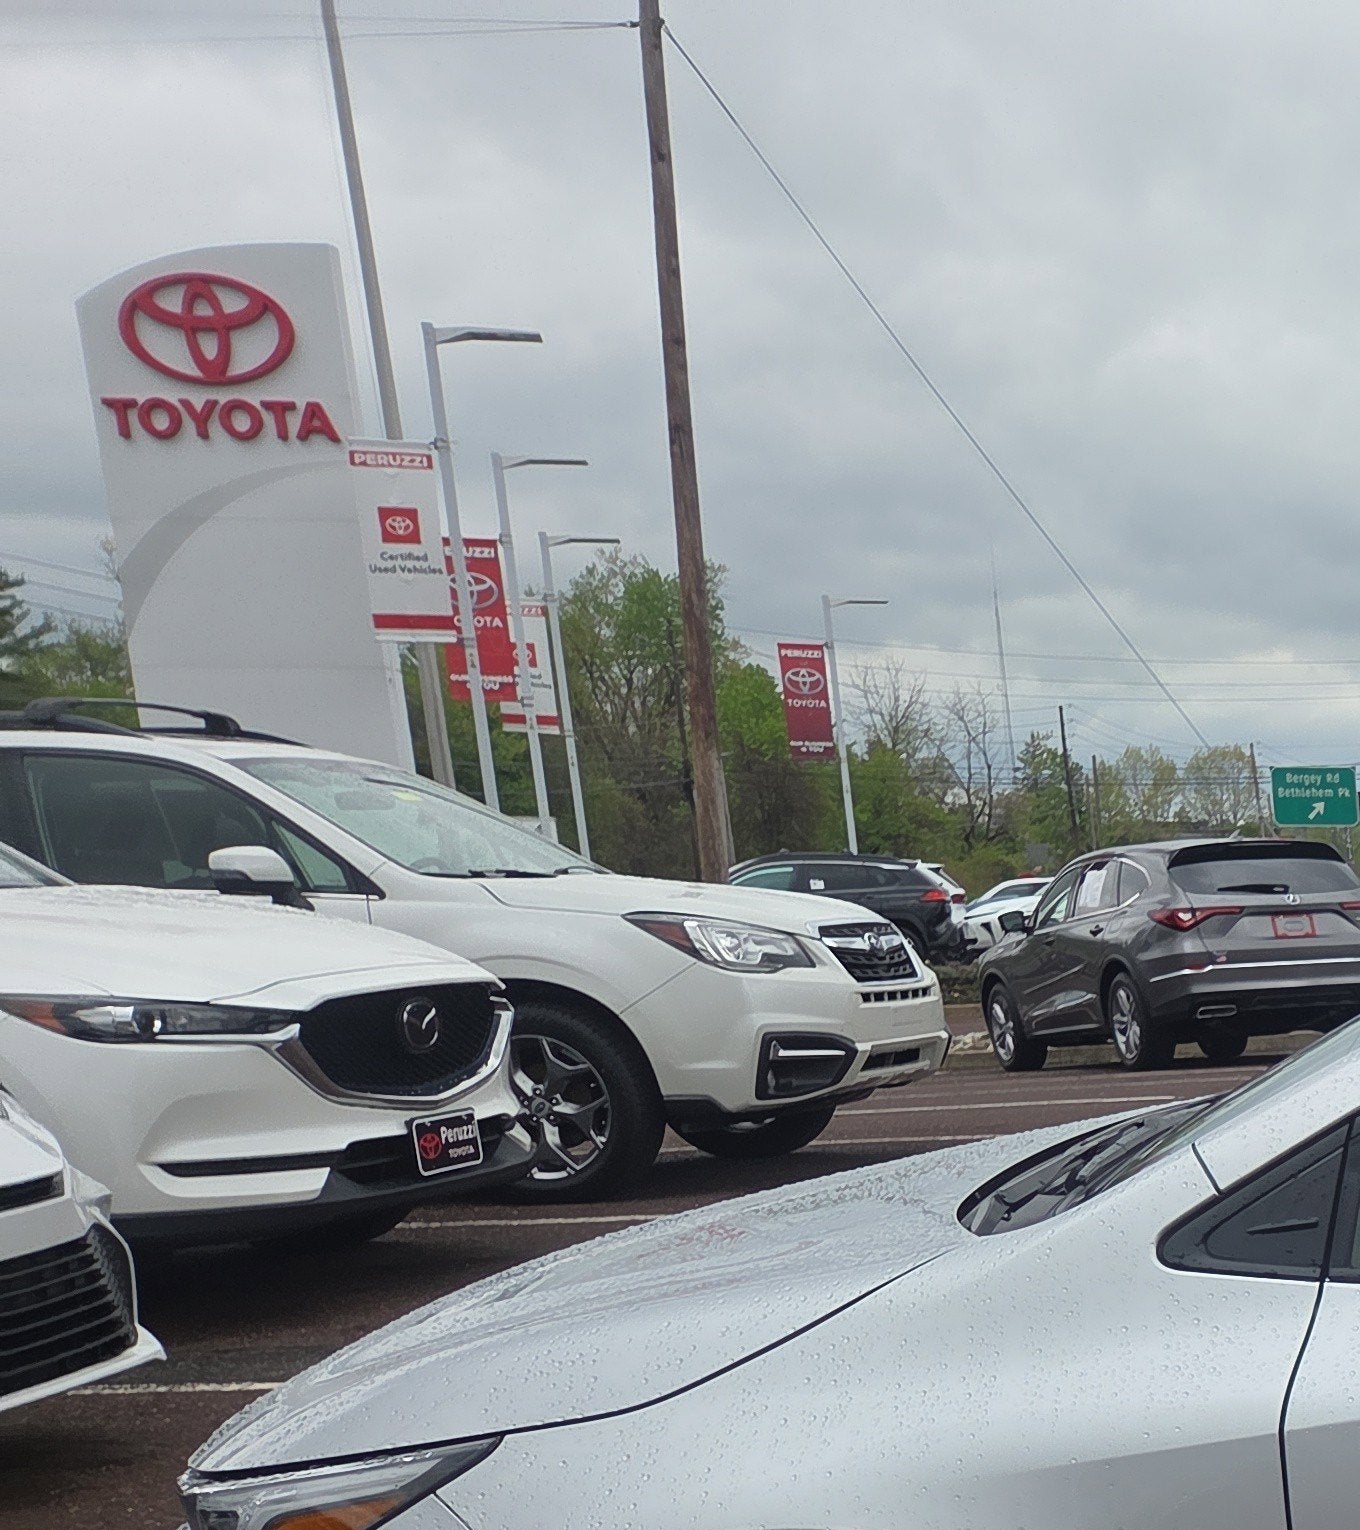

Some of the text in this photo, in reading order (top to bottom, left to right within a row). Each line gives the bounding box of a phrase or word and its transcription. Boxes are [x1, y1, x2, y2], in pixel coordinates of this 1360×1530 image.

[101, 396, 342, 443] TOYOTA
[353, 452, 429, 468] PERUZZI
[379, 550, 429, 563] Certified
[369, 563, 444, 576] Used Vehicles
[786, 698, 827, 708] TOYOTA
[1285, 772, 1340, 786] Bergey Rd
[1278, 786, 1351, 798] Bethlehem Pk
[440, 1121, 477, 1144] Peruzzi
